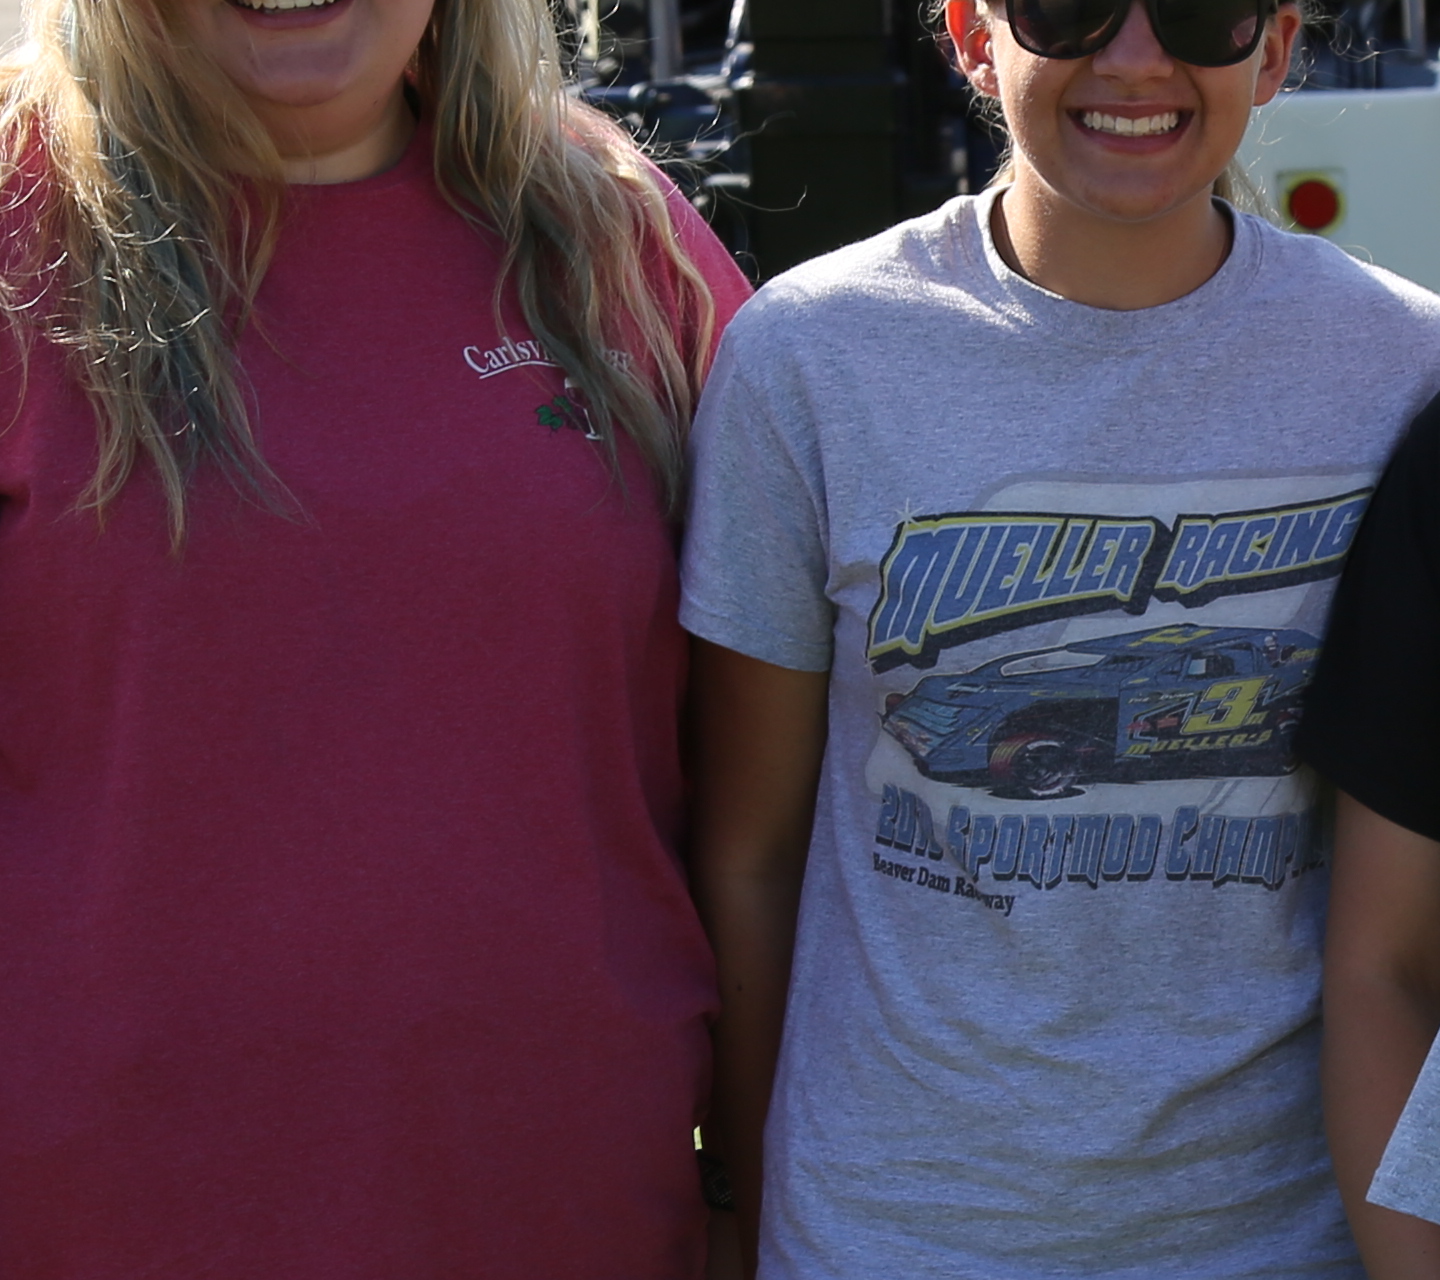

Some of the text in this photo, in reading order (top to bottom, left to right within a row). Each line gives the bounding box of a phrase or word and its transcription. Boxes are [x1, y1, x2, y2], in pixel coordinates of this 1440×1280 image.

[868, 492, 1372, 657] MUELLER RACING
[916, 866, 951, 893] Dam
[946, 804, 1161, 891] SPORTMOD
